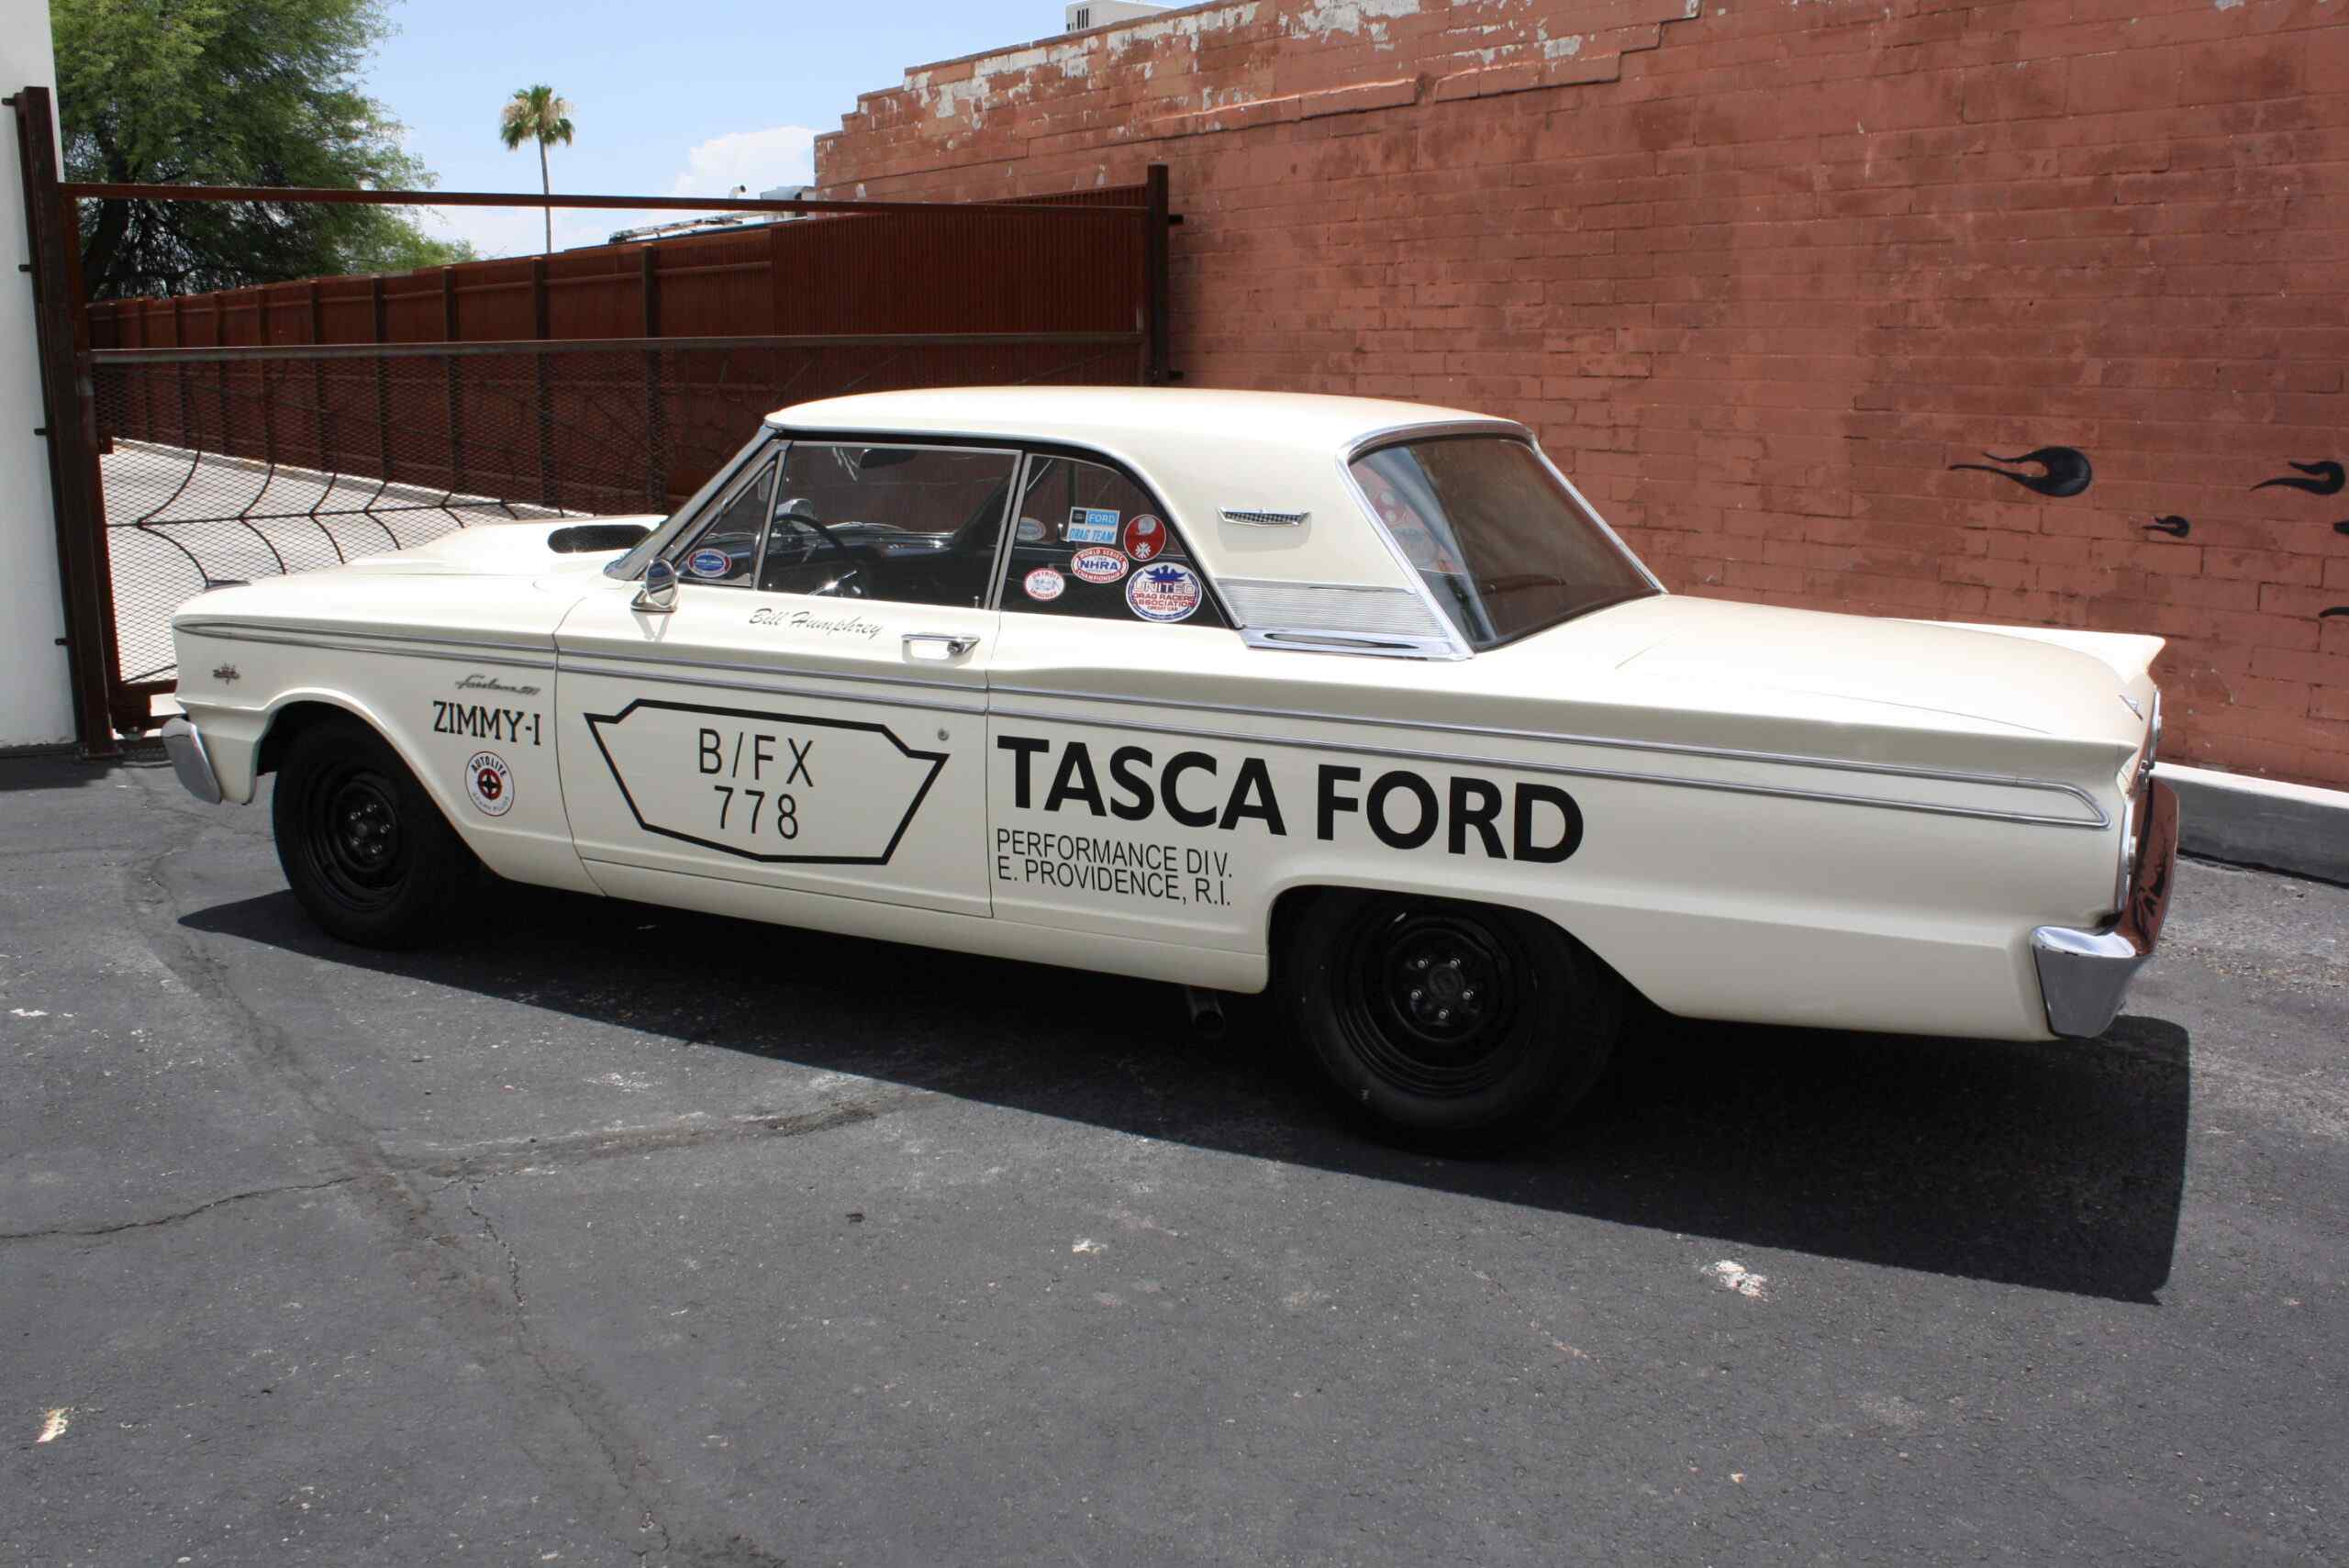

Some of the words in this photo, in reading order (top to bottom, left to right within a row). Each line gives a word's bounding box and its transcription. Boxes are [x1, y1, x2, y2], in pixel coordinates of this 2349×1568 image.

[1089, 513, 1115, 523] FORD
[1092, 529, 1115, 542] TEAM
[1080, 561, 1118, 570] NHRA
[1133, 581, 1196, 595] UNITED
[1159, 594, 1196, 602] RACERS
[1132, 598, 1196, 608] ASSOCIATION
[749, 607, 788, 626] Bill
[790, 611, 883, 639] Humphrey
[433, 700, 540, 746] ZIMMY-I
[471, 755, 507, 778] AUTOLITE
[698, 728, 815, 787] B/FX
[714, 784, 799, 840] 778
[997, 735, 1287, 837] TASCA
[1317, 764, 1584, 864] FORD
[997, 828, 1177, 872] PERFORMANCE
[1186, 849, 1233, 878] DIV.
[998, 856, 1019, 882] E.
[1026, 859, 1187, 905] PROVIDENCE,
[1195, 877, 1231, 906] R.I.
